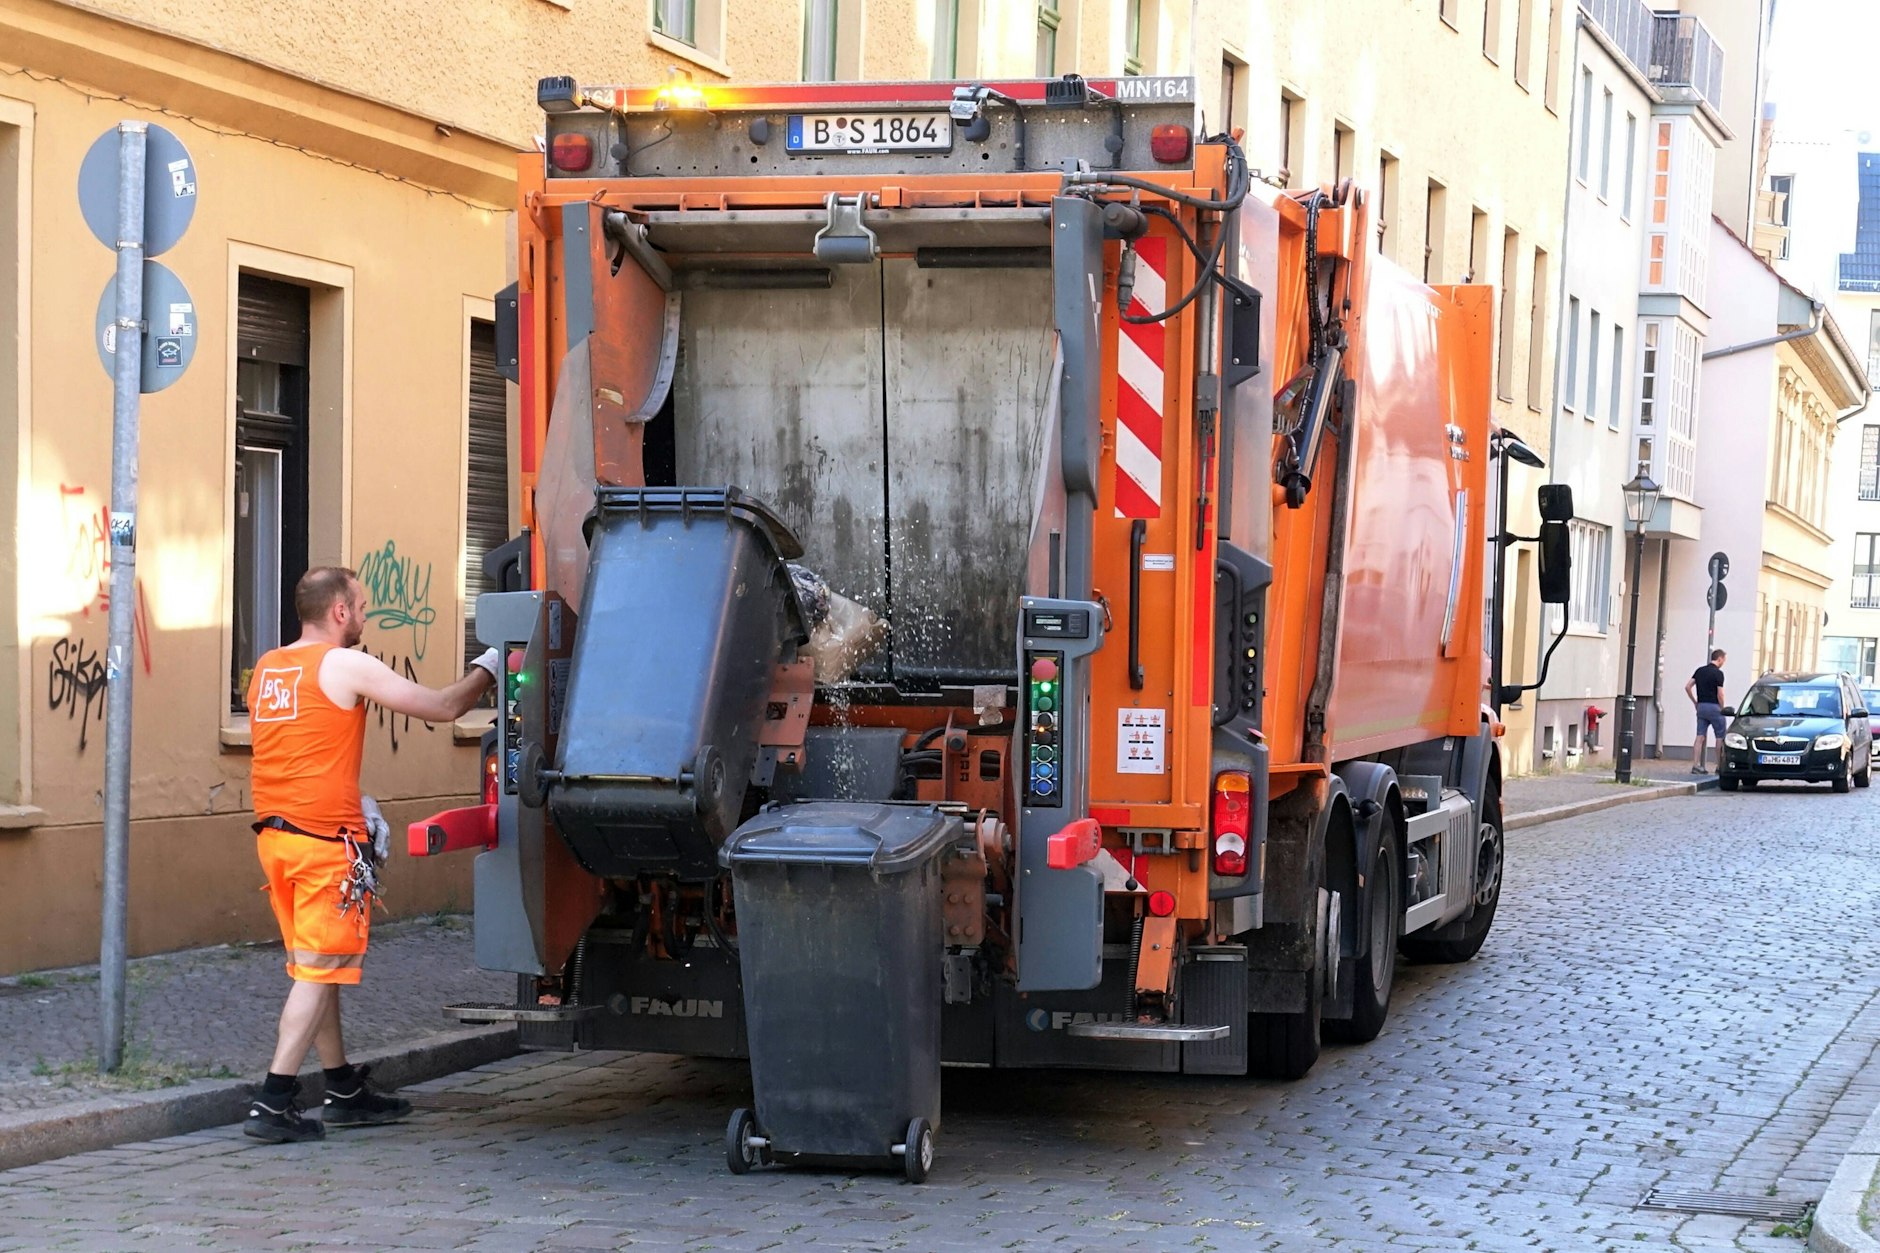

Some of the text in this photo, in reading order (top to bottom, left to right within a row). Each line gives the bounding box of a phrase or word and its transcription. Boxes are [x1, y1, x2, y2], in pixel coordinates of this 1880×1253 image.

[1117, 79, 1188, 98] MN164
[814, 117, 938, 144] B S 1864
[261, 678, 291, 711] BSR
[631, 996, 723, 1018] FAUN
[1052, 1011, 1125, 1029] FAU
